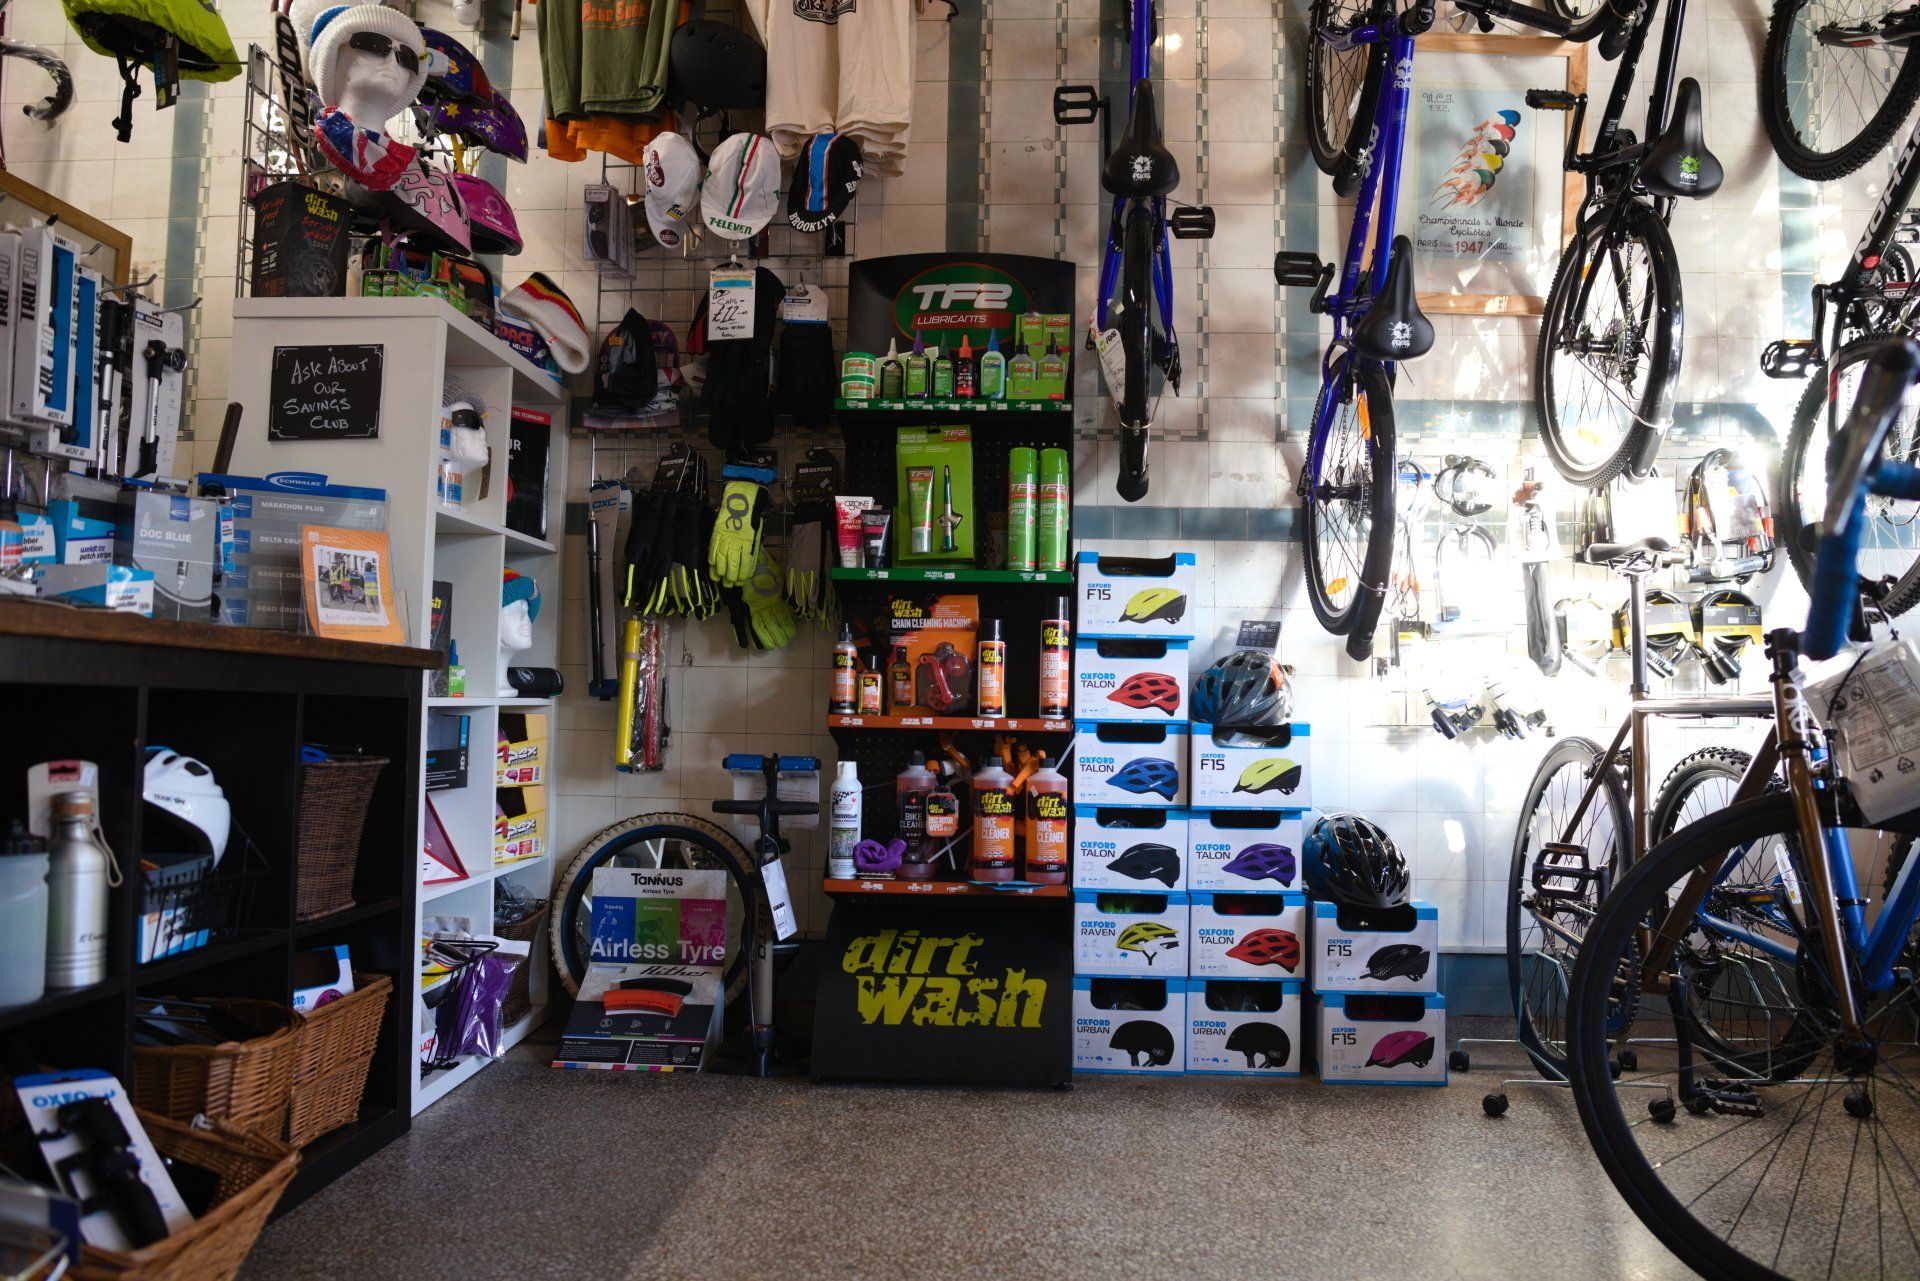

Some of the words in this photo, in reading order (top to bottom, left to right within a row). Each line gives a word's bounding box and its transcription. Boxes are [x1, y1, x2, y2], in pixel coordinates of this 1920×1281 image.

[304, 192, 328, 209] dirt
[307, 205, 338, 222] wash
[709, 216, 753, 237] 7-ELEVEN
[788, 211, 837, 233] BROOKLYN
[1494, 216, 1524, 228] Monde
[1455, 240, 1484, 254] 1947
[20, 247, 39, 322] TRUFLO
[912, 283, 1013, 311] TF2
[917, 314, 988, 326] LUBRICANTS
[290, 358, 323, 385] ASK
[327, 355, 369, 375] ABOUT
[313, 381, 347, 395] OUR
[283, 398, 351, 415] SAVINGS
[309, 415, 349, 430] CLUB
[278, 477, 322, 487] SCHWALBE
[261, 501, 303, 511] MARATHON
[305, 504, 325, 513] PLUS
[140, 528, 162, 539] DOC
[165, 531, 192, 543] BLUE
[259, 535, 282, 544] DELTA
[79, 552, 96, 561] patch
[258, 570, 284, 579] RANGE
[1087, 588, 1112, 600] F15
[891, 599, 913, 609] dirt
[894, 607, 923, 618] wash
[891, 618, 911, 629] CHAIN
[911, 619, 942, 629] CLEANING
[943, 619, 972, 628] MACHINE
[1045, 636, 1069, 646] wash
[1081, 680, 1116, 689] TALON
[1079, 756, 1115, 764] OXFORD
[1200, 758, 1225, 771] F15
[1080, 764, 1114, 773] TALON
[982, 793, 1004, 803] dirt
[1037, 796, 1060, 807] dirt
[984, 802, 1012, 813] wash
[1039, 806, 1067, 817] wash
[905, 813, 922, 821] BIKE
[982, 817, 997, 829] BIKE
[1036, 821, 1053, 832] BIKE
[982, 828, 1010, 839] CLEANER
[1036, 832, 1064, 843] CLEANER
[1080, 841, 1116, 849] OXFORD
[1081, 848, 1116, 858] TALON
[1195, 851, 1231, 860] TALON
[1081, 921, 1116, 929] OXFORD
[1081, 928, 1116, 937] RAVEN
[1198, 928, 1235, 937] OXFORD
[1199, 936, 1234, 945] TALON
[590, 937, 669, 960] Airless
[677, 939, 726, 964] Tyre
[842, 929, 985, 975] dirt
[1327, 944, 1352, 957] F15
[856, 967, 1048, 1028] wash
[1076, 1018, 1111, 1027] OXFORD
[1192, 1020, 1227, 1028] OXFORD
[1076, 1026, 1110, 1034] URBAN
[1192, 1028, 1226, 1036] URBAN
[1331, 1033, 1357, 1045] F15
